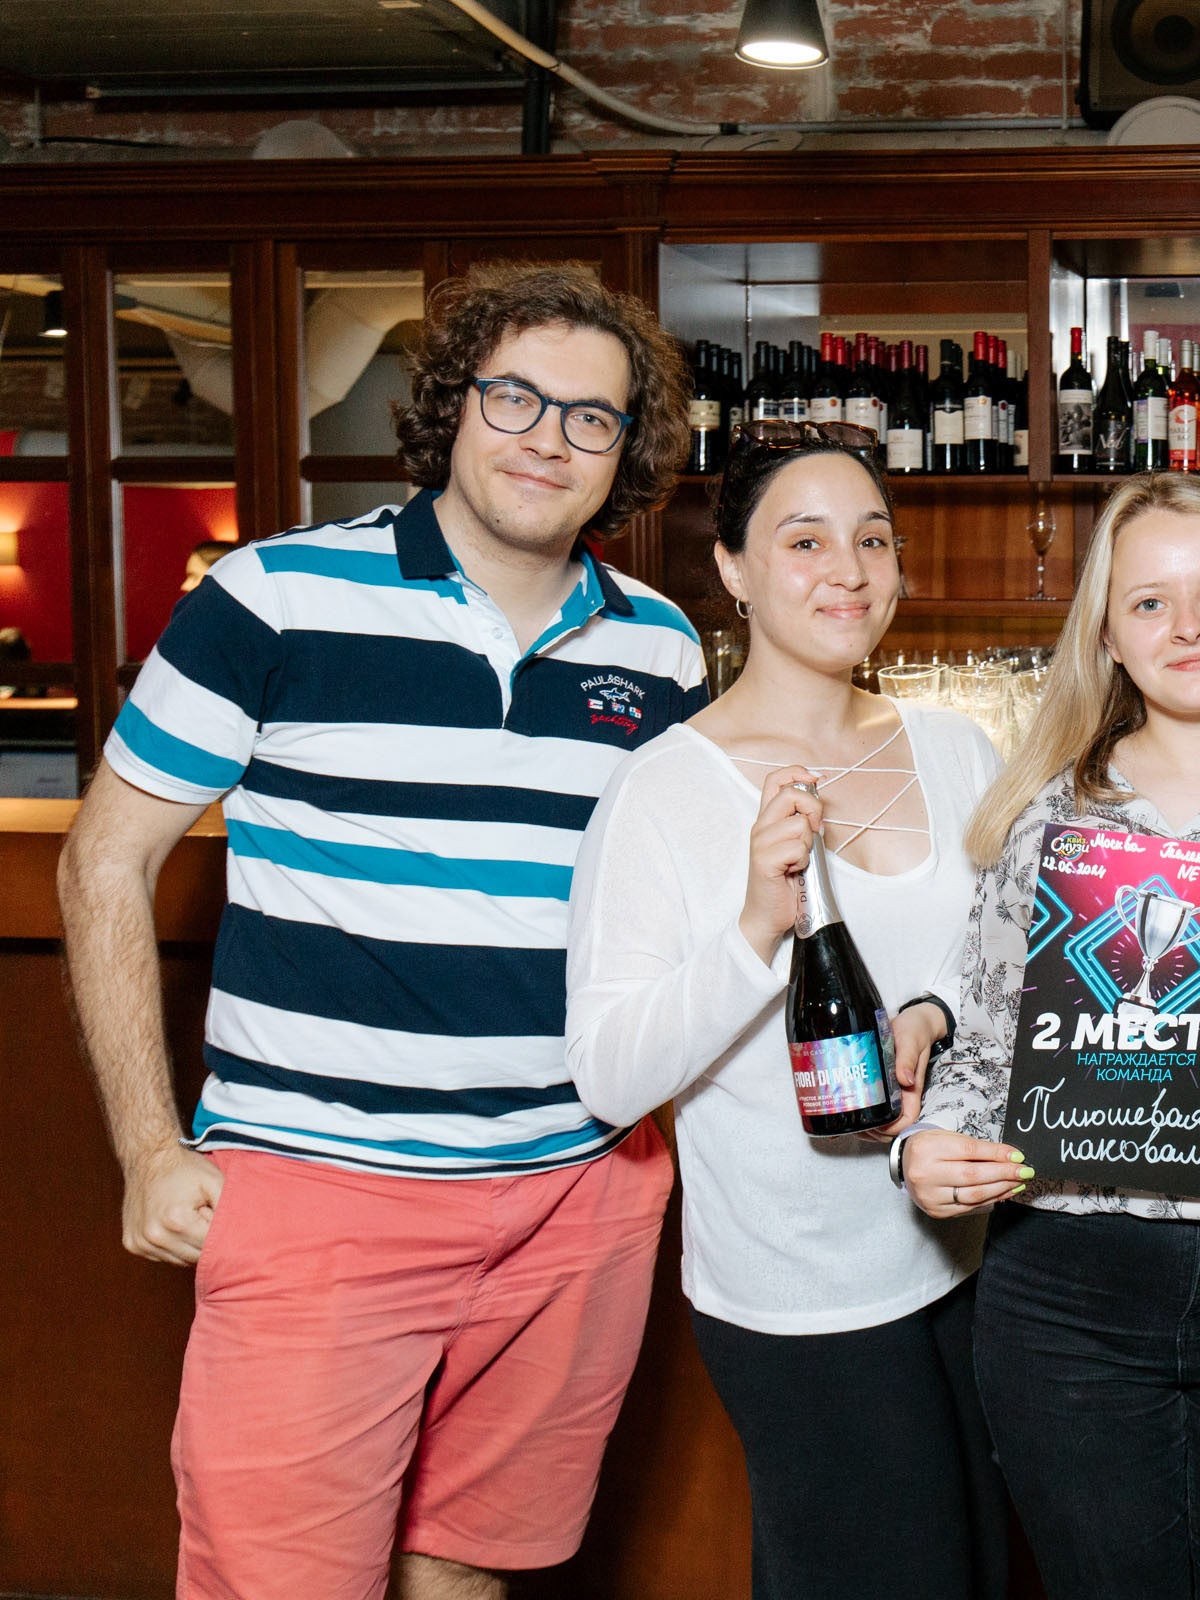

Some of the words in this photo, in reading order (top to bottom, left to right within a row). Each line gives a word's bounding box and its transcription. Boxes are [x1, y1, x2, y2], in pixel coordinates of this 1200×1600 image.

[1050, 836, 1090, 854] Смузи
[1090, 832, 1147, 853] Москва
[1032, 1012, 1061, 1050] 2
[1077, 1052, 1197, 1067] НАГРАЖДАЕТСЯ
[794, 1071, 816, 1088] FIORI
[817, 1069, 830, 1087] DI
[832, 1062, 869, 1084] MARE
[1096, 1068, 1173, 1083] КОМАНДА
